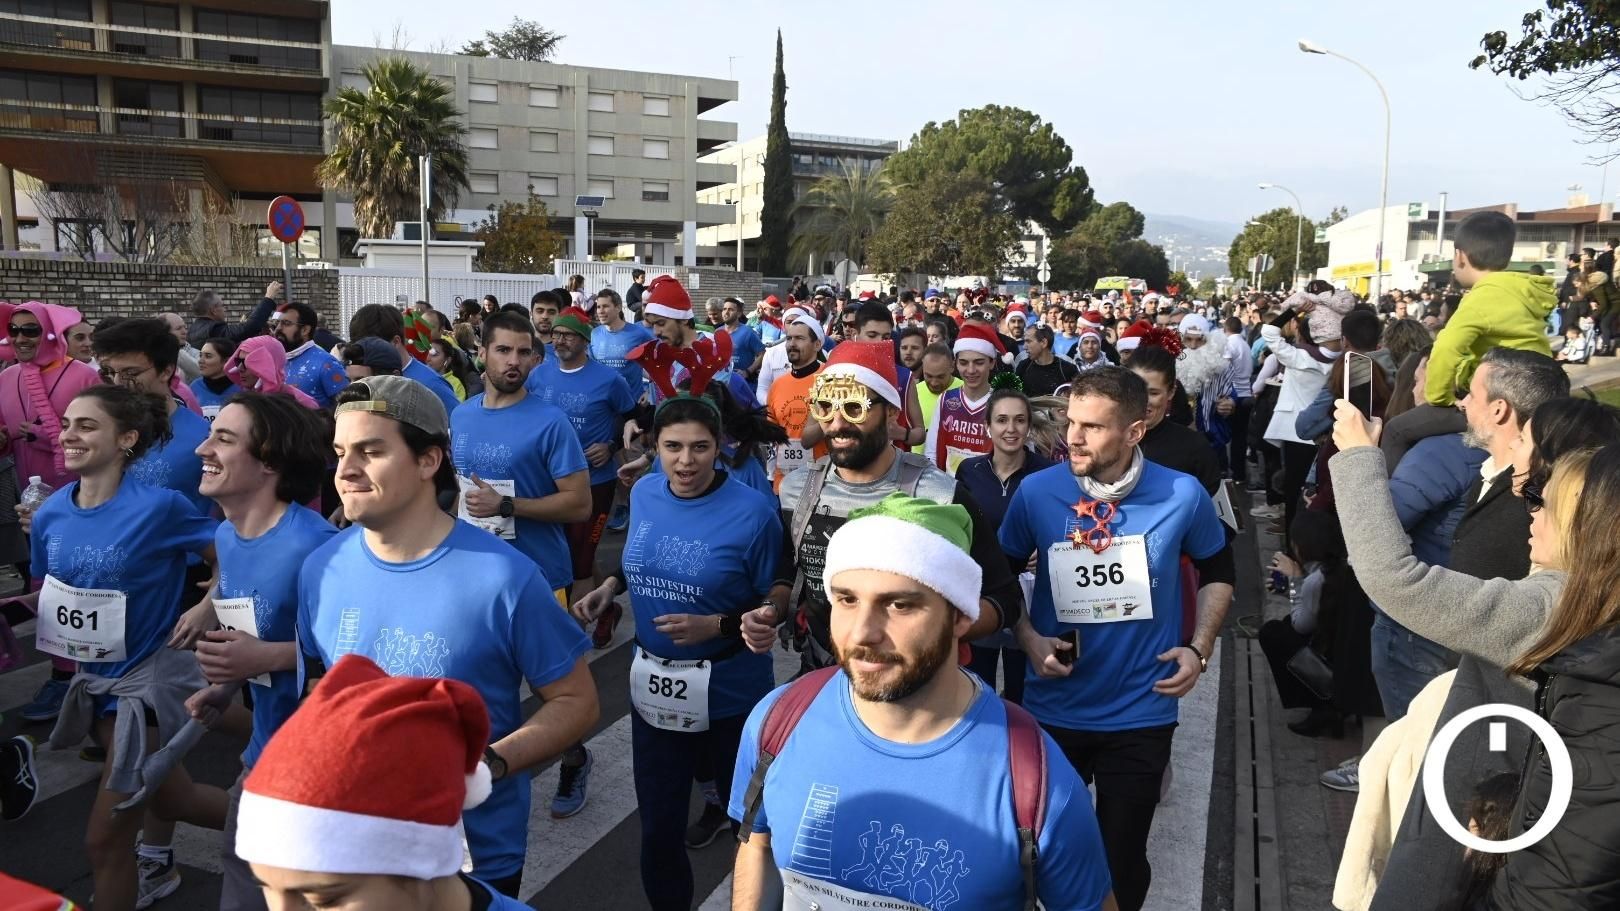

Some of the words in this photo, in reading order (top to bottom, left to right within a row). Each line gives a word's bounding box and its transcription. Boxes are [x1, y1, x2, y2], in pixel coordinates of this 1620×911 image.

[942, 414, 984, 436] MARIST
[783, 449, 803, 460] 583
[626, 573, 643, 584] SAN
[645, 575, 704, 596] SILVESTRE
[1075, 562, 1125, 588] 356
[632, 585, 697, 604] CORDOBESA
[56, 605, 98, 631] 661
[648, 673, 688, 700] 582
[803, 882, 820, 892] SAN
[821, 887, 871, 908] SILVESTRE
